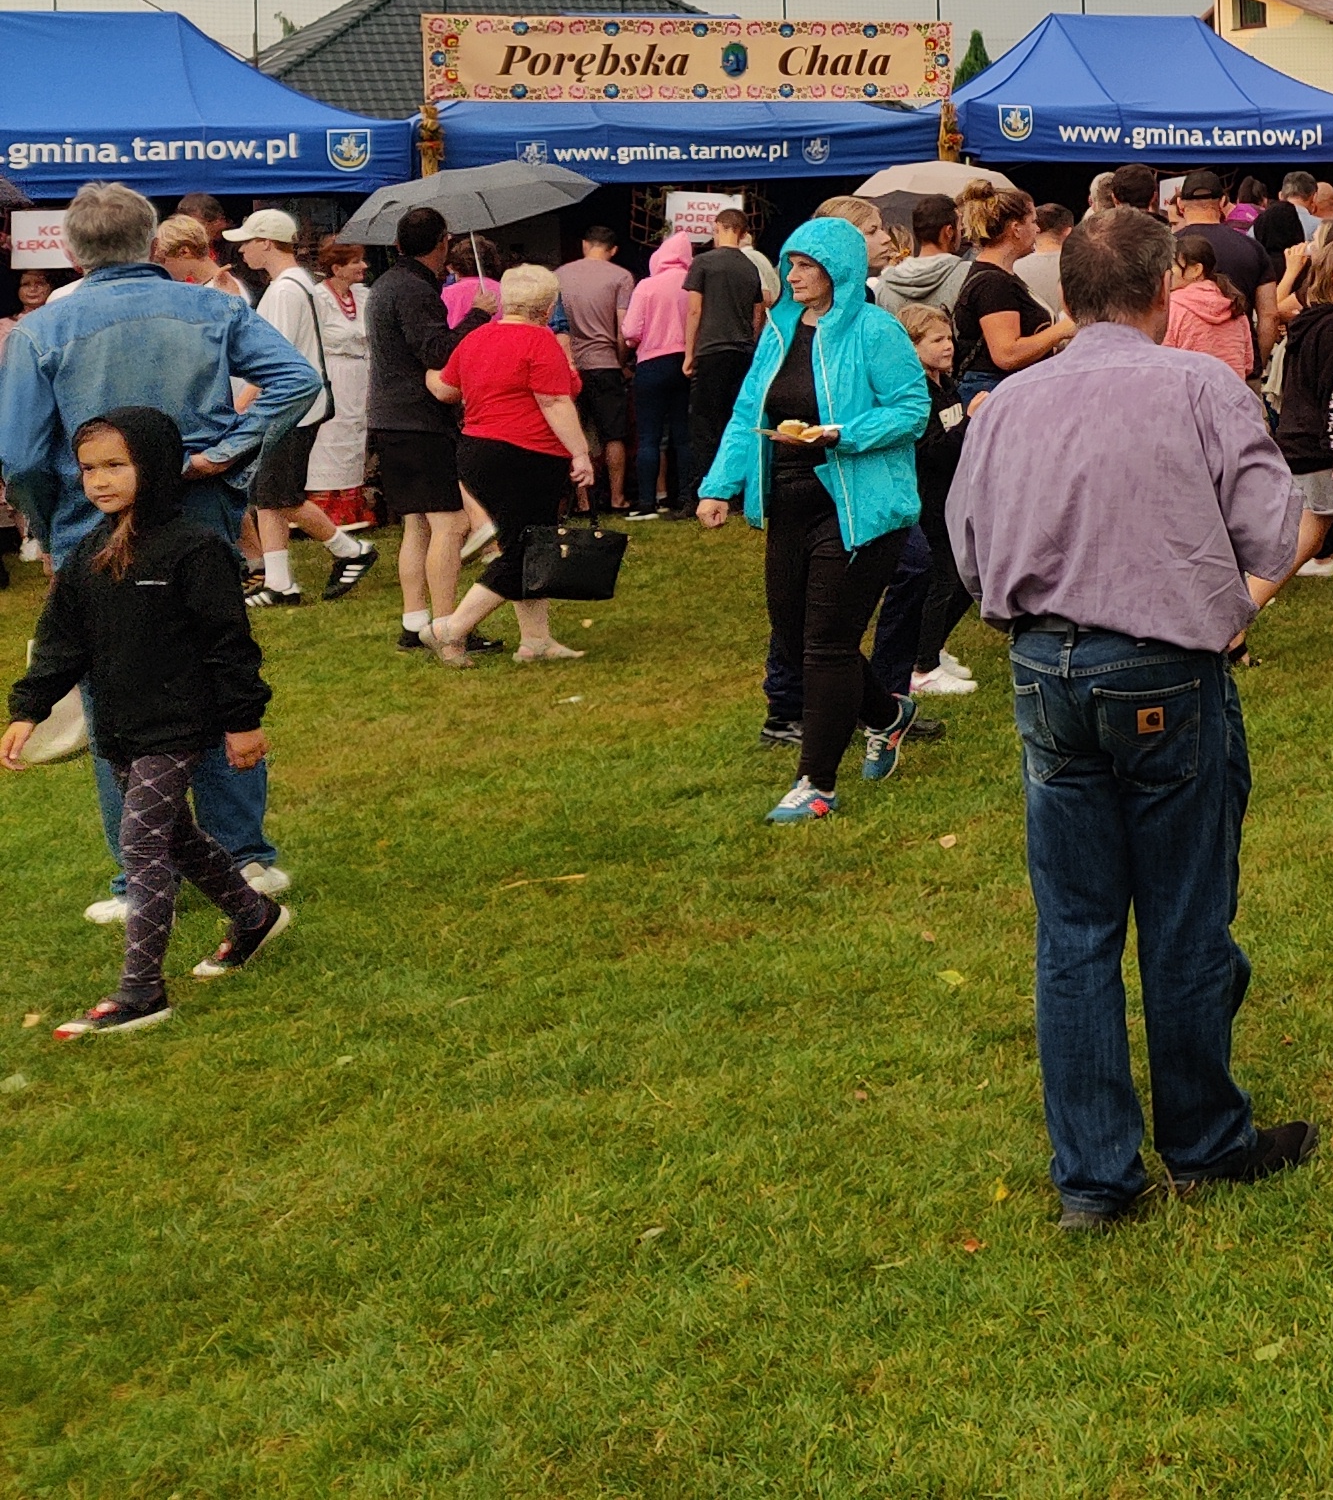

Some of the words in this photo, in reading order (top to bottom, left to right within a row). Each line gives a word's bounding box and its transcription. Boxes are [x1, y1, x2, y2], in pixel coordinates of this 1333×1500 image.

[497, 43, 690, 83] Porębska
[777, 45, 891, 76] Chata
[1059, 124, 1322, 150] www.gmina.tarnow.pl
[552, 141, 789, 163] www.gmina.tarnow.pl
[38, 225, 61, 236] KG
